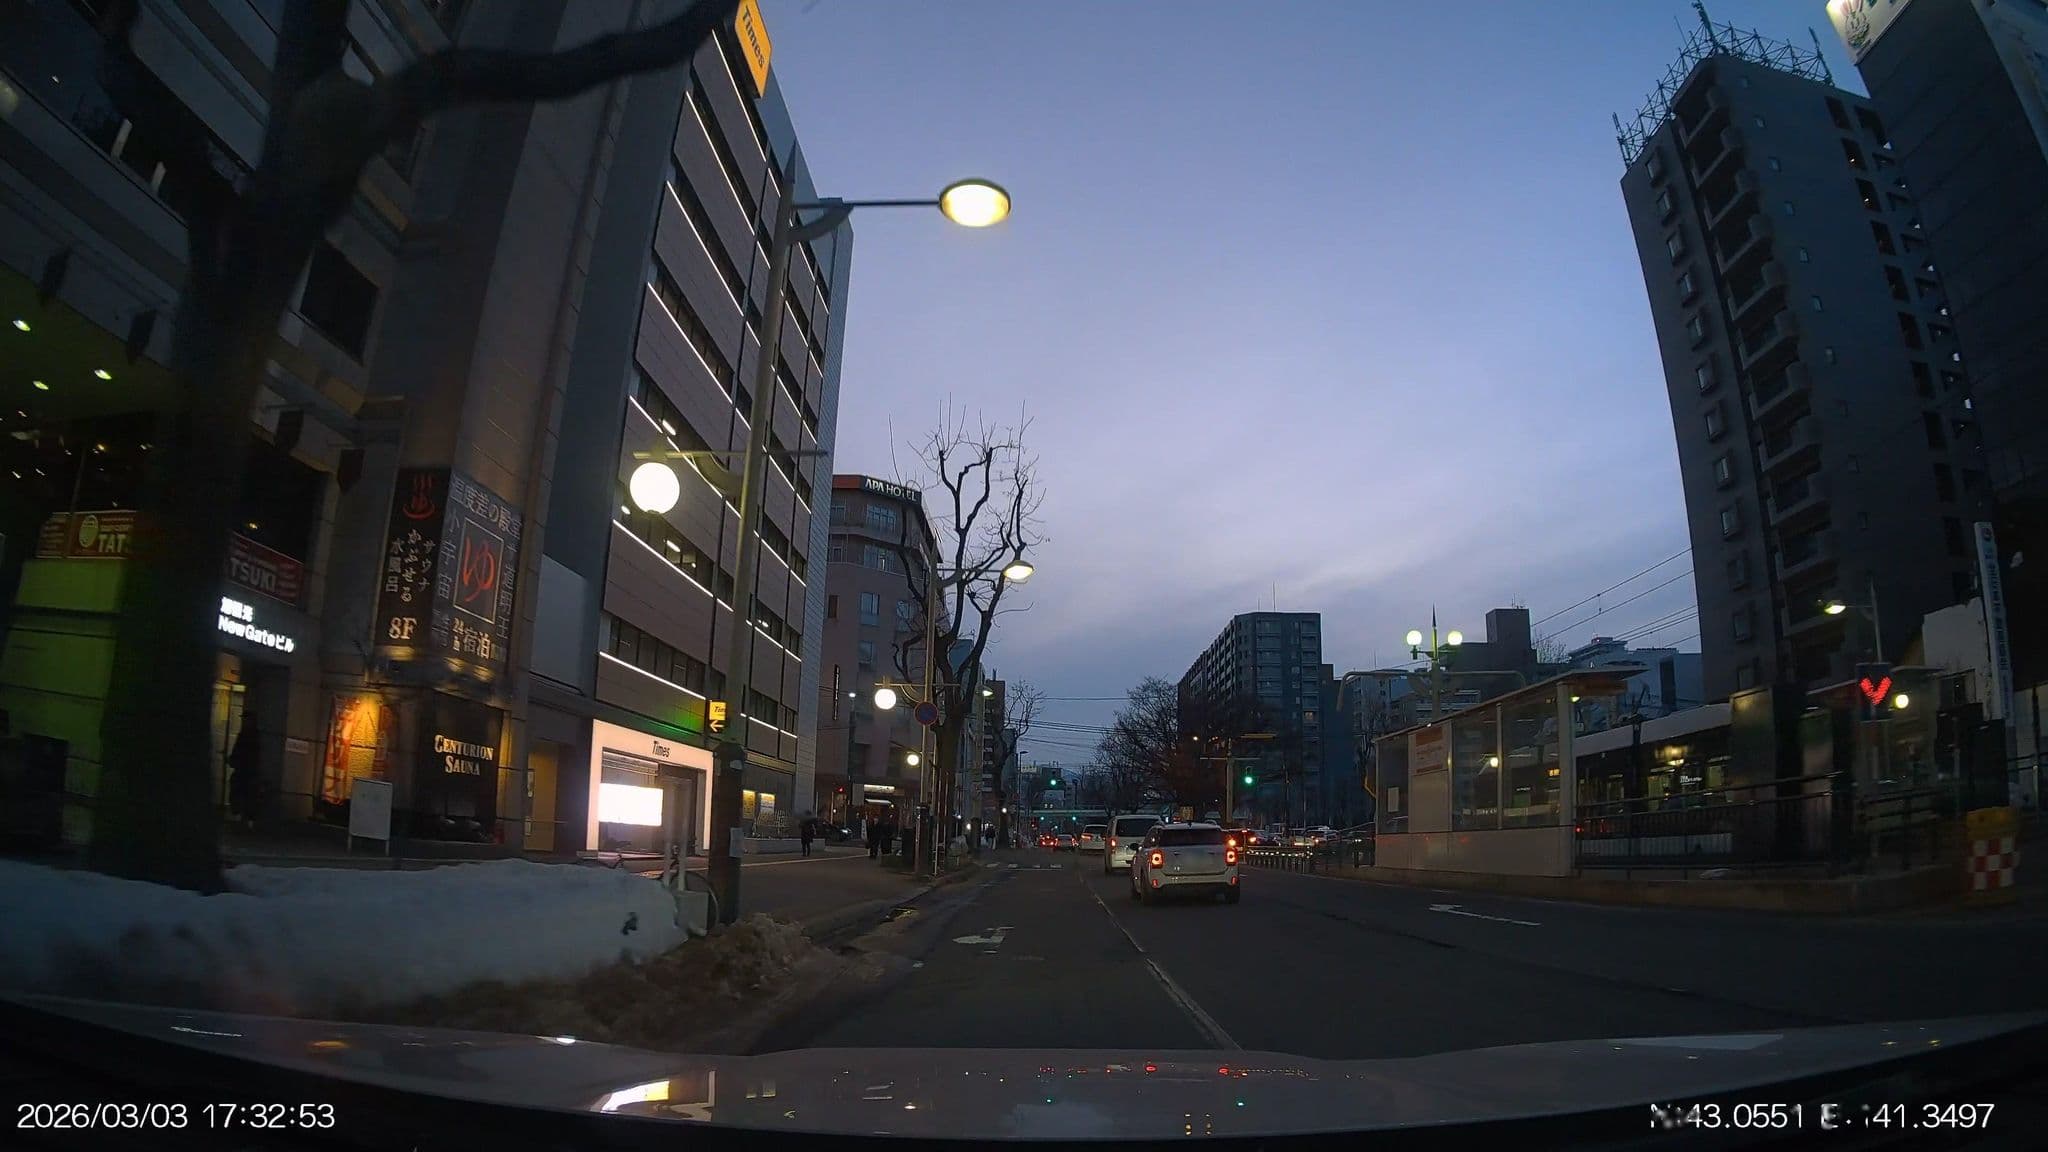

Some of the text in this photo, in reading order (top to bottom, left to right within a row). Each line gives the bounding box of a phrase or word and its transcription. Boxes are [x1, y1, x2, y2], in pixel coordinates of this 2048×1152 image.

[865, 478, 917, 501] APA HOTEL
[389, 617, 417, 640] 8F
